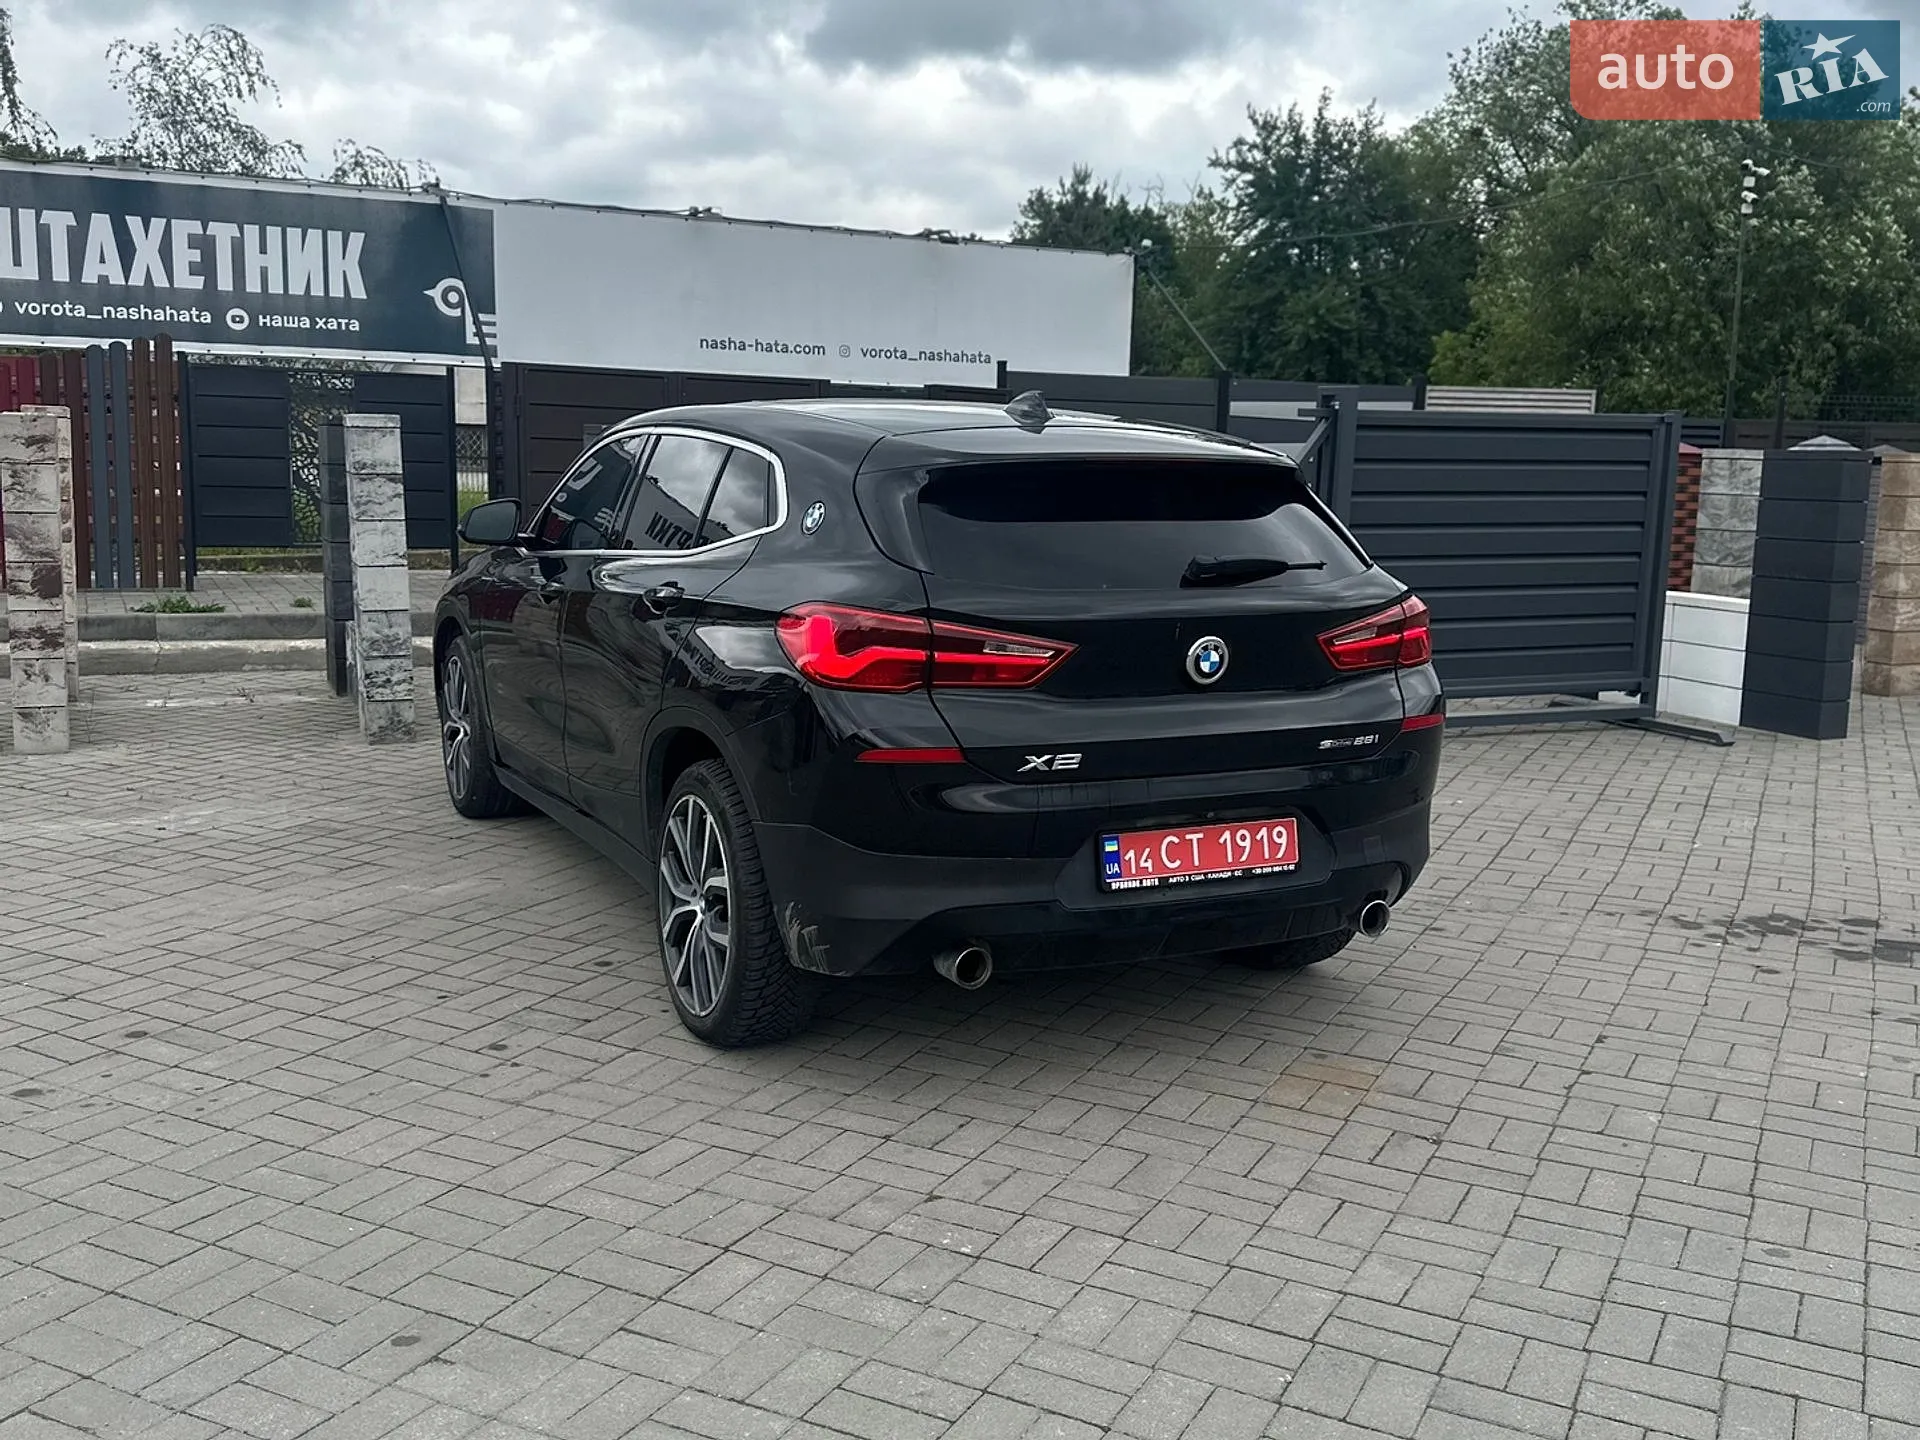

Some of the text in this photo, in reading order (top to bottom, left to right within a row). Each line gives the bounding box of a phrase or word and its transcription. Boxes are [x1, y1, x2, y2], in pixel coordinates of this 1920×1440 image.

[14, 300, 212, 325] vorota_nashahata
[258, 314, 360, 331] наша хата
[699, 337, 826, 356] nasha-hata.com
[860, 346, 992, 364] vorota_nashahata
[1017, 753, 1083, 772] X2
[1124, 825, 1288, 875] 14 CT 1919
[1106, 863, 1120, 875] UA
